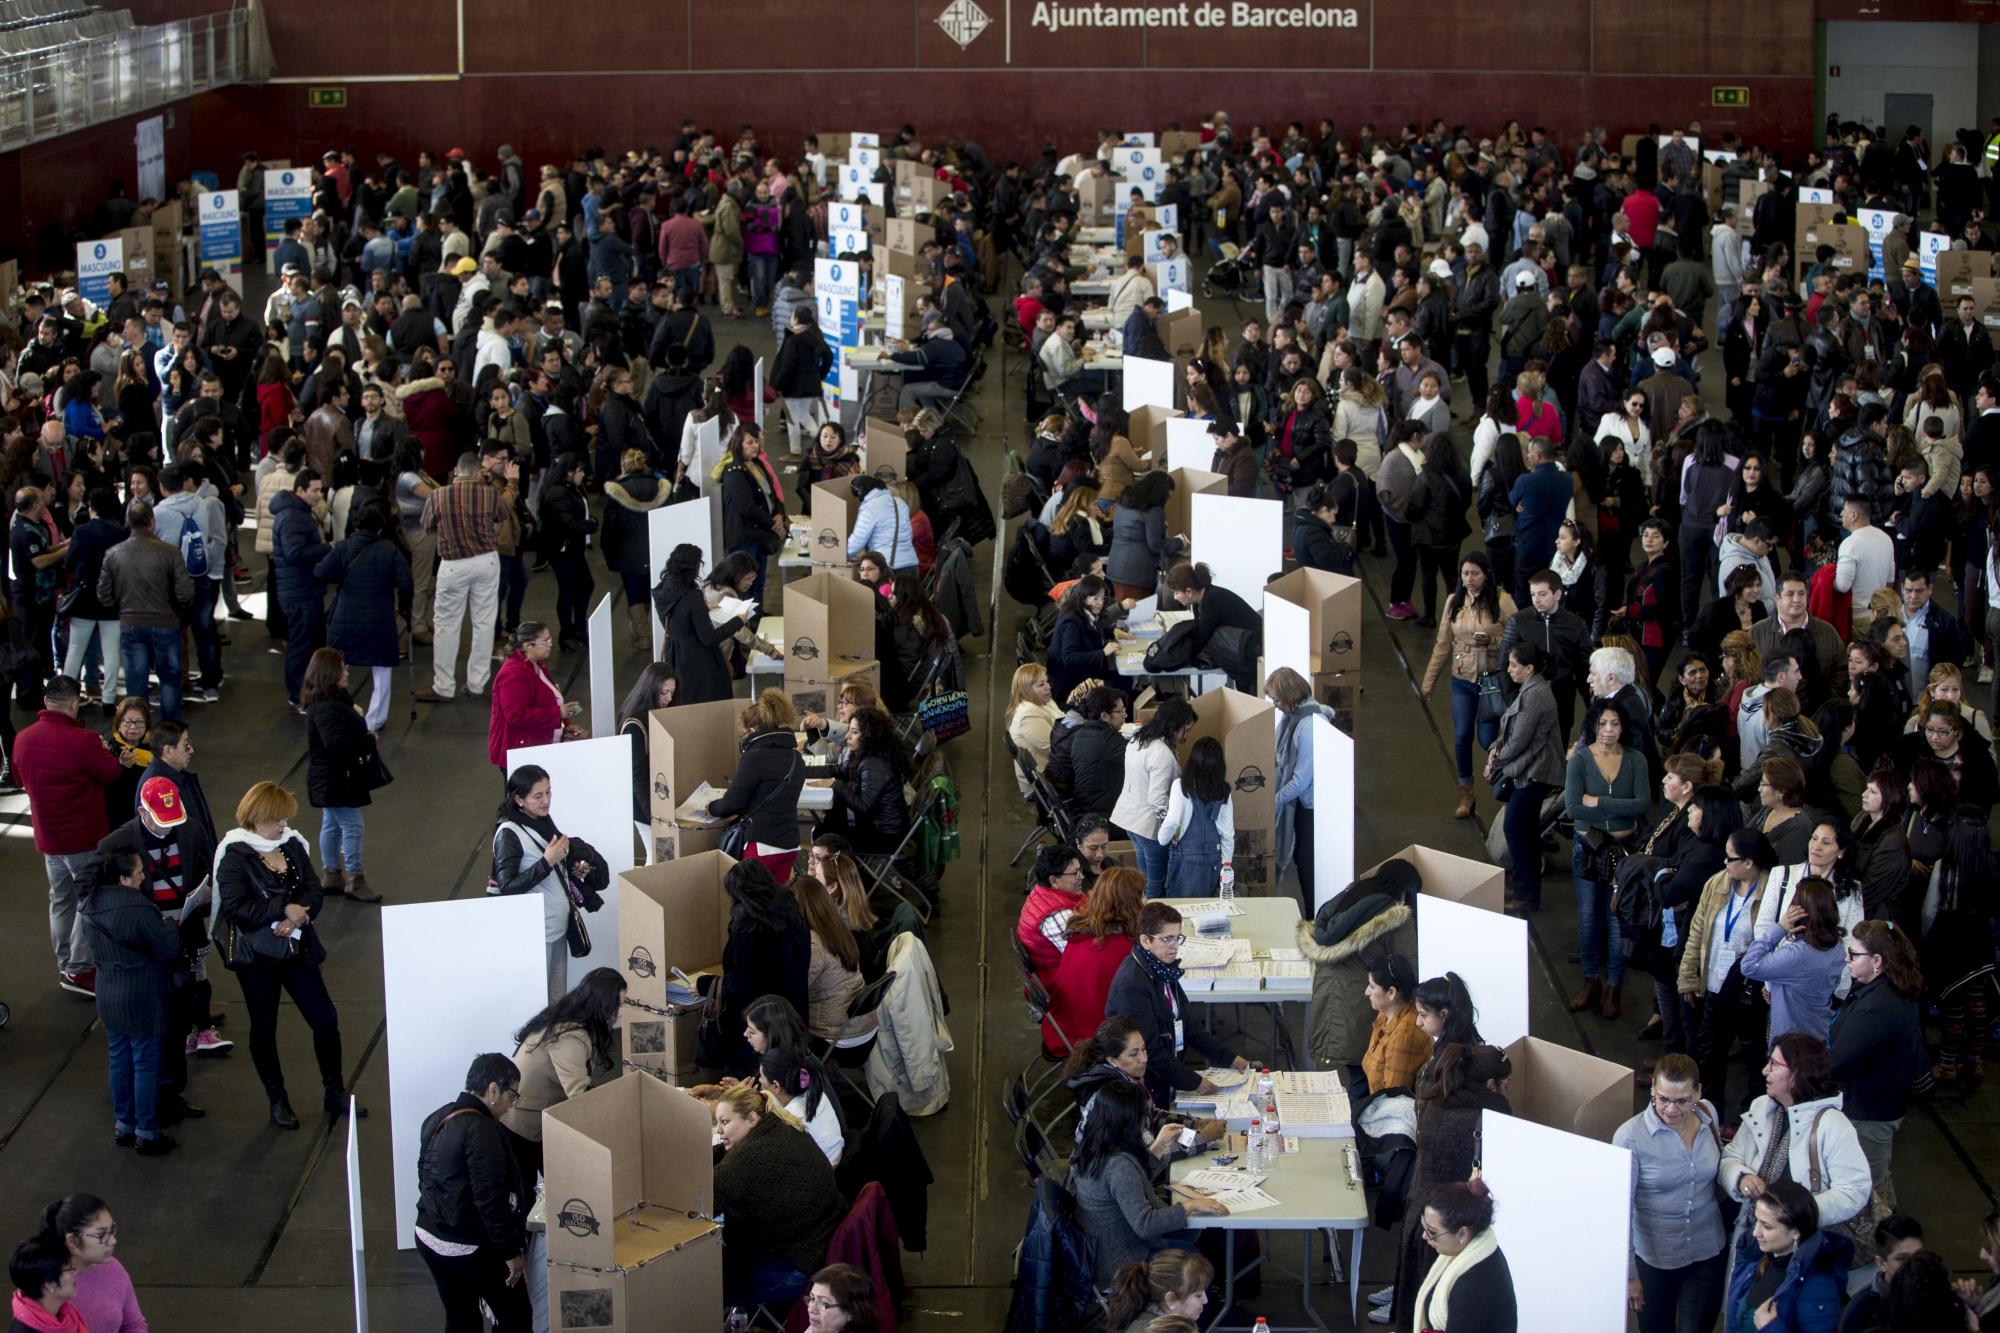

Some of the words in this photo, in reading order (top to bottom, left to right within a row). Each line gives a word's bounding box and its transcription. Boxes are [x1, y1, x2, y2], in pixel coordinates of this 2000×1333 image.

[1031, 2, 1189, 32] Ajuntament
[1194, 2, 1225, 27] de
[1231, 2, 1358, 28] Barcelona
[80, 259, 121, 273] MASCULINO
